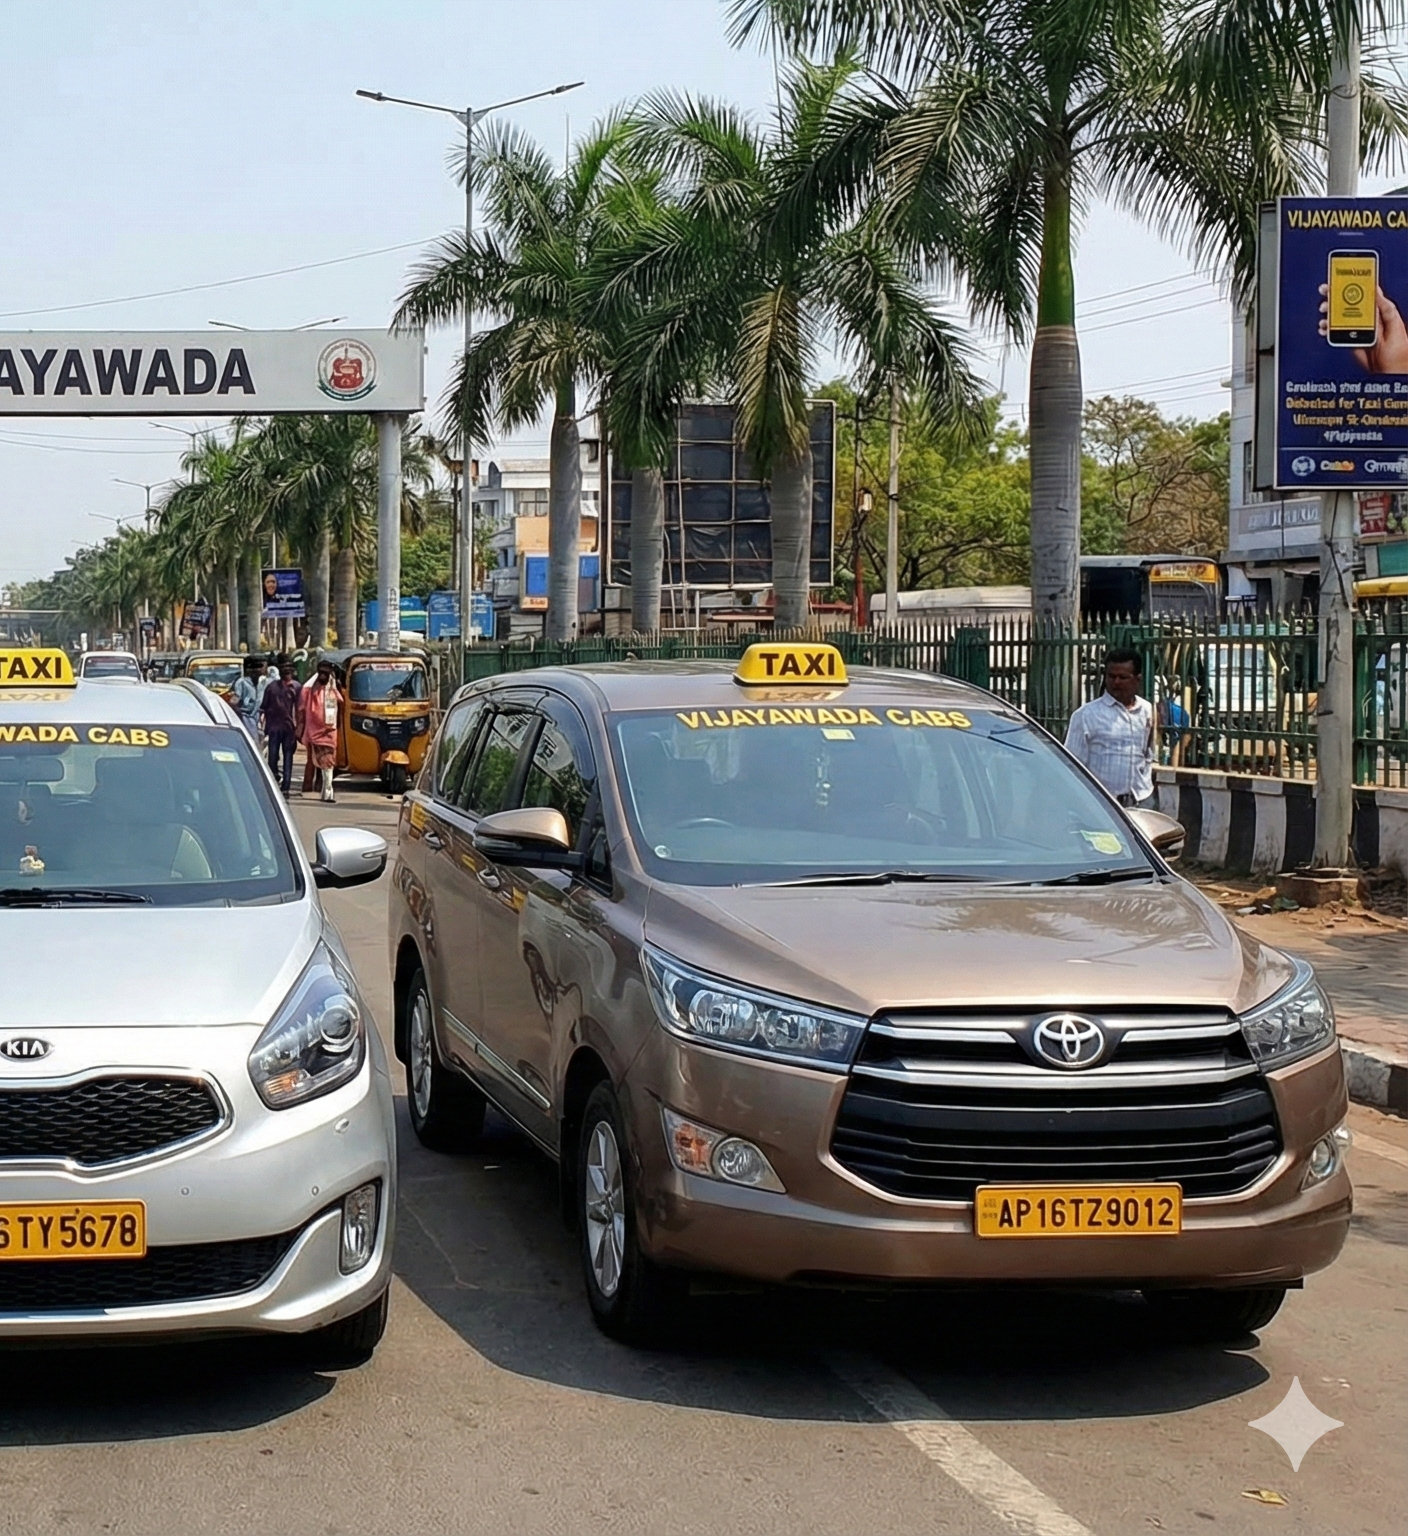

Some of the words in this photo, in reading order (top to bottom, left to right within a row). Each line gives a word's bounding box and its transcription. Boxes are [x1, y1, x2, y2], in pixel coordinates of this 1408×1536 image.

[1287, 209, 1383, 229] VIJAYAWADA
[1386, 209, 1408, 229] CA
[759, 653, 835, 677] TAXI
[676, 708, 883, 730] VIJAYAWADA
[886, 708, 973, 729] CABS
[87, 727, 169, 747] CABS
[6, 1040, 45, 1056] KIA
